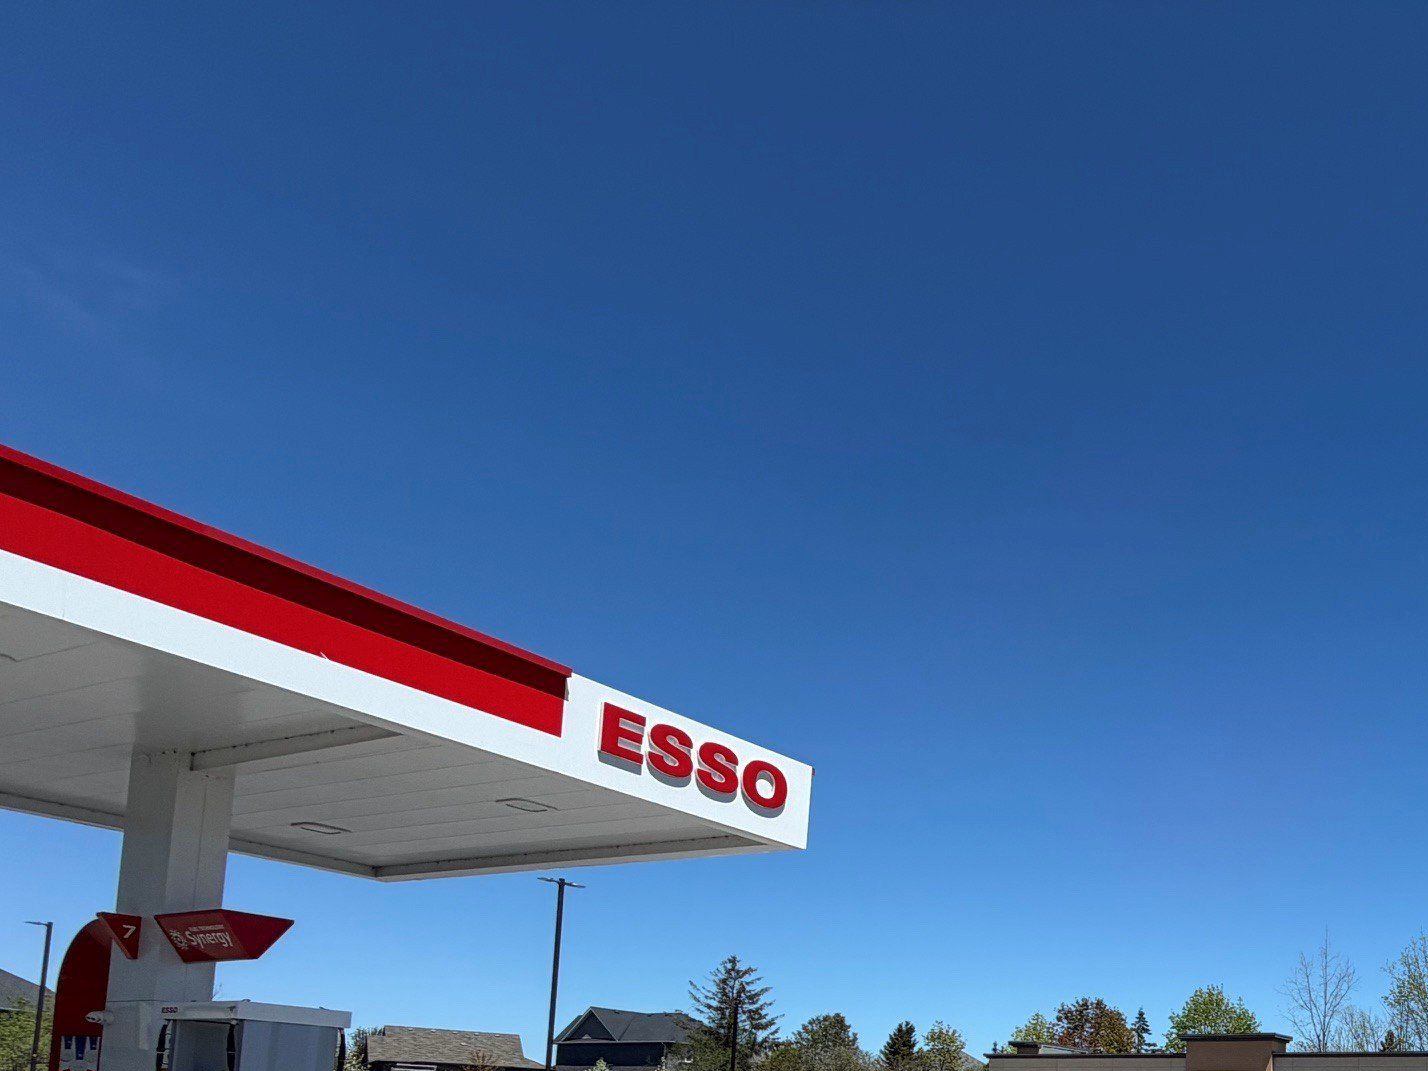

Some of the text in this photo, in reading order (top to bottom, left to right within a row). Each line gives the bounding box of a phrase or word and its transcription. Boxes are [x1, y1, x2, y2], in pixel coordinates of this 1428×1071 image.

[599, 702, 788, 818] ESSO
[122, 925, 136, 938] 7
[185, 930, 234, 949] Synergy
